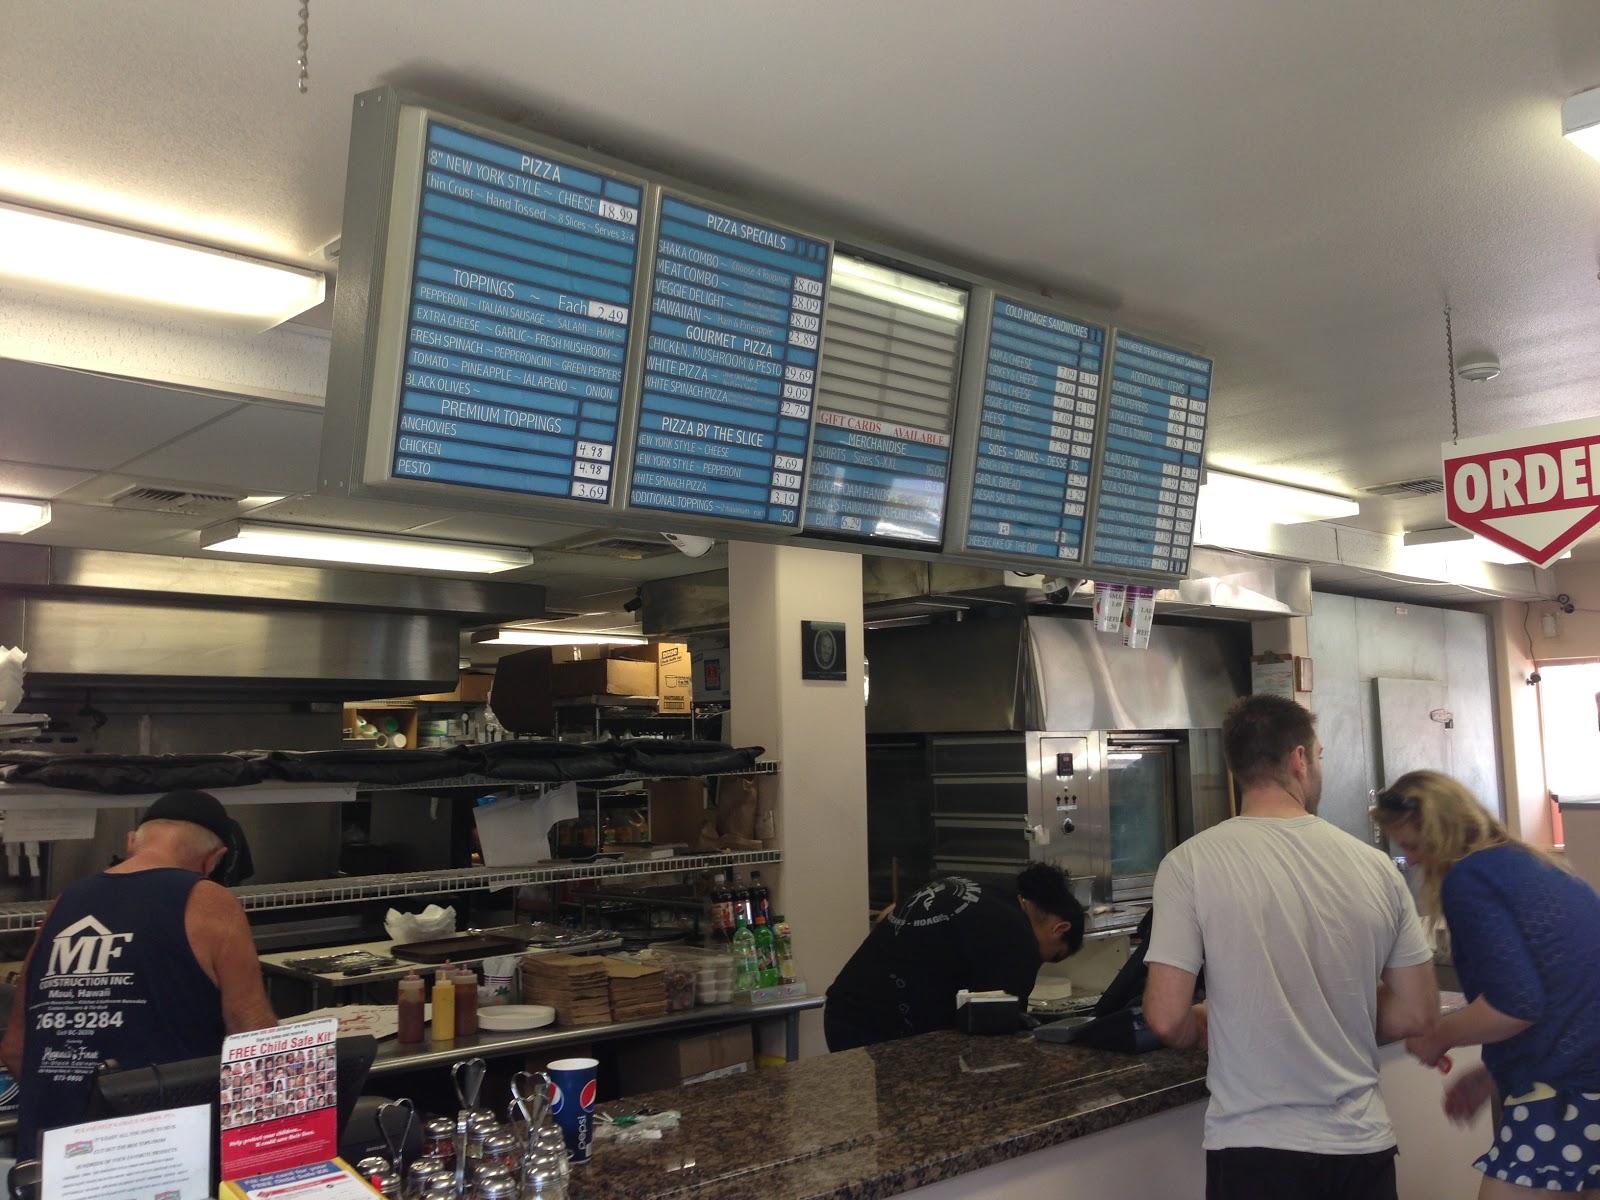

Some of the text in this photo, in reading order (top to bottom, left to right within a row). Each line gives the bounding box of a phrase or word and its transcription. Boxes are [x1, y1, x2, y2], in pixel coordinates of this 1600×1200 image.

[521, 156, 561, 183] PIZZA
[446, 154, 632, 222] NEW YORK STYLE CHEESE 18.99
[427, 174, 446, 190] Thin
[448, 180, 473, 199] Crust
[487, 193, 511, 210] Hand
[514, 200, 546, 220] Tossed
[558, 214, 564, 224] 8
[565, 215, 586, 231] Slices
[594, 223, 619, 238] Serves
[707, 214, 786, 250] PIZZA SPECIALS
[658, 240, 687, 257] SHAKA
[689, 249, 718, 268] COMBO
[454, 268, 624, 323] TOPPINGS Each 2.49
[657, 258, 681, 278] MEAT
[684, 267, 718, 287] COMBO
[792, 297, 818, 312] 28.09
[421, 287, 614, 339] PEPPERONI ITALIAN SAUSAGE SALAMI HAM
[656, 280, 687, 300] VEGGIE
[689, 290, 725, 308] DELIGHT
[790, 314, 817, 329] 28.09
[1006, 304, 1022, 318] COLD
[1024, 311, 1047, 327] HOAGIE
[1049, 318, 1088, 338] SANDWICHES
[417, 308, 610, 359] EXTRA CHEESE GARLIC FRESH MUSHROOM
[653, 298, 700, 322] HAWAIIAN
[739, 320, 773, 336] Pineapple
[789, 331, 815, 346] 23.89
[411, 329, 621, 381] FRESH SPINACH PEPPERONCINI GREEN PEPPERS
[686, 325, 772, 358] GOURMET PIZZA
[414, 351, 612, 398] TOMATO PINEAPPLE JALAPENO ONION
[646, 356, 677, 376] WHITE
[679, 363, 708, 382] PIZZA
[692, 346, 811, 382] MUSHROOM & PESTO 29.69
[406, 373, 470, 394] BLACK OLIVES
[644, 375, 668, 391] WHITE
[671, 381, 703, 396] SPINACH
[705, 388, 728, 402] PIZZA
[780, 402, 806, 417] 22.79
[442, 399, 561, 434] PREMIUM TOPPINGS
[662, 417, 763, 447] PIZZA BY THE SLICE
[821, 413, 944, 445] GIFT CARDS AVAILABLE
[401, 416, 602, 457] ANCHOVIES 4.98
[655, 436, 797, 469] YORK STYLE CHEESE 2.69
[849, 433, 907, 455] MERCHANDISE
[989, 444, 1006, 457] SIDES
[400, 438, 602, 475] CHICKEN 4.98
[653, 456, 795, 487] YORK STYLE PEPPERONI 3.19
[811, 462, 830, 476] HATS
[853, 452, 896, 470] Sizes S-XXL
[398, 459, 603, 498] PESTO 3.69
[634, 473, 794, 504] WHITE SPINACH PIZZA 3.19
[631, 490, 793, 523] ADDITIONAL TOPPINGS .50
[843, 517, 859, 529] 6.29
[46, 933, 134, 976] MF
[78, 988, 111, 997] Hawaii
[110, 976, 133, 986] INC.
[229, 1045, 256, 1060] FREE
[260, 1039, 287, 1054] Child
[291, 1035, 313, 1048] Safe
[317, 1032, 331, 1043] Kit
[577, 1116, 588, 1150] pepsi
